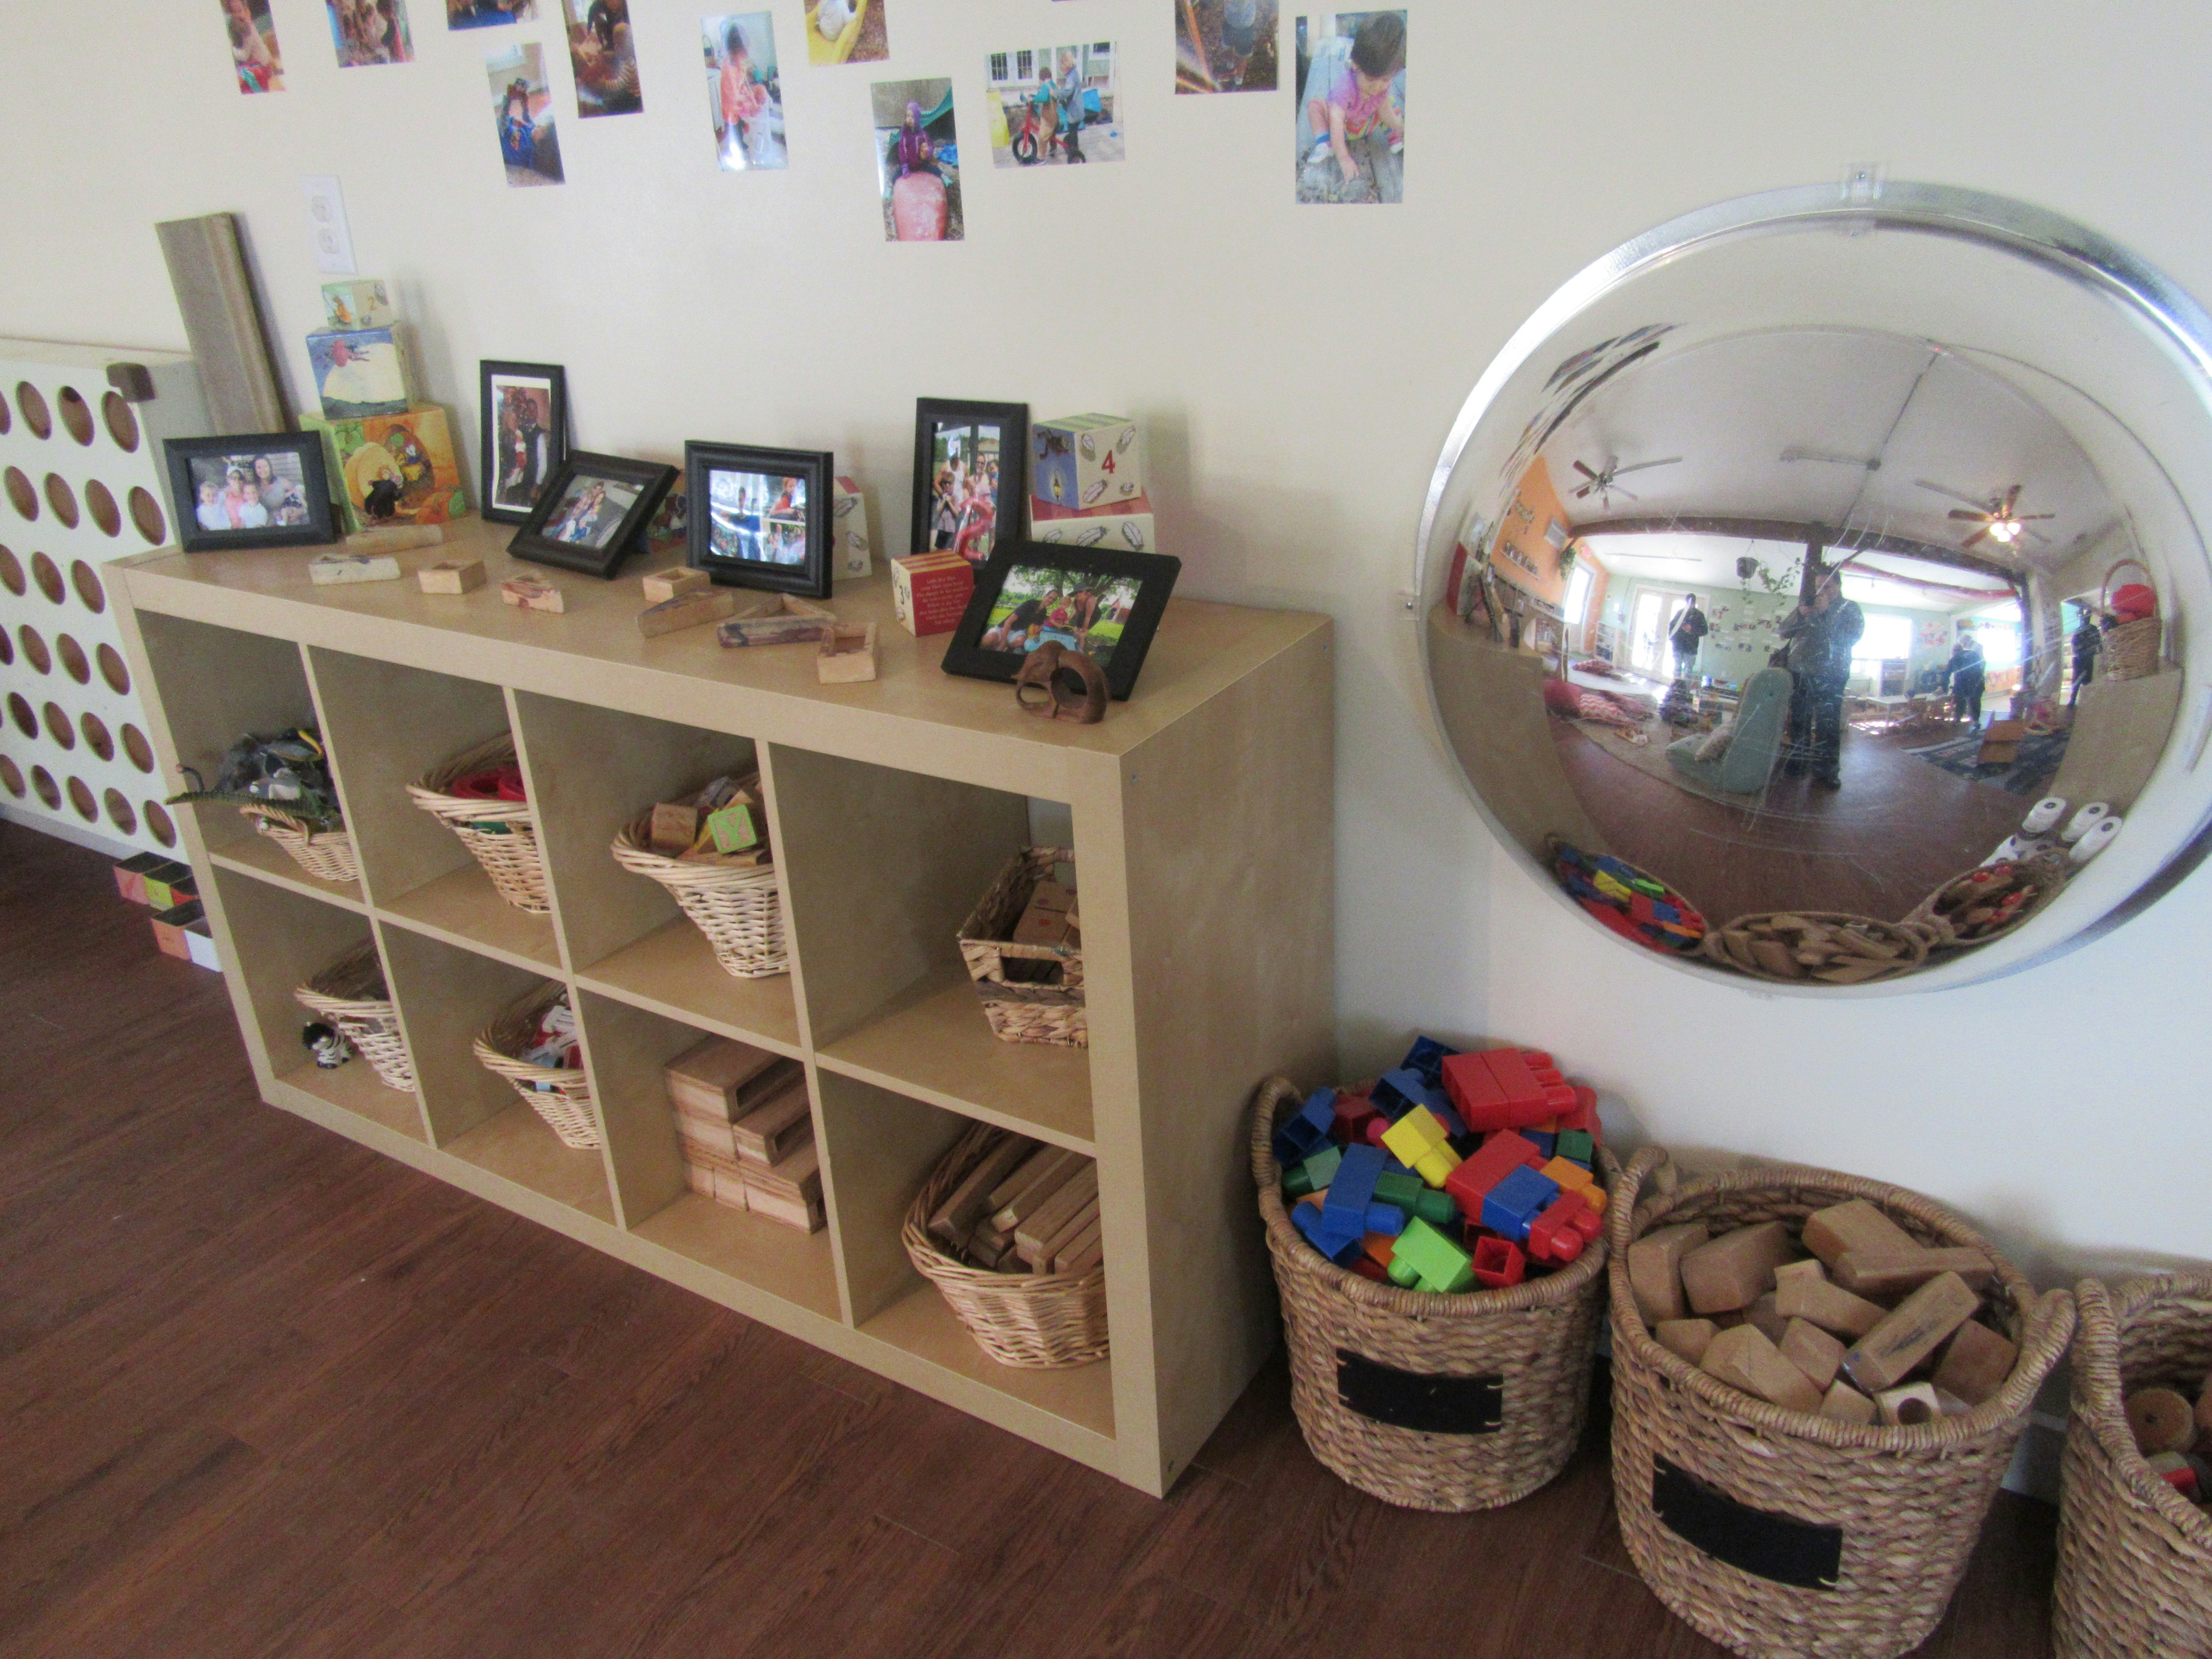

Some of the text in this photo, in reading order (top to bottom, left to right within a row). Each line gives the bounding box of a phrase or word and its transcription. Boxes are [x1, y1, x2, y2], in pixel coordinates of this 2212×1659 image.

[1102, 450, 1115, 474] 4
[899, 585, 904, 605] 3
[716, 814, 742, 844] Y
